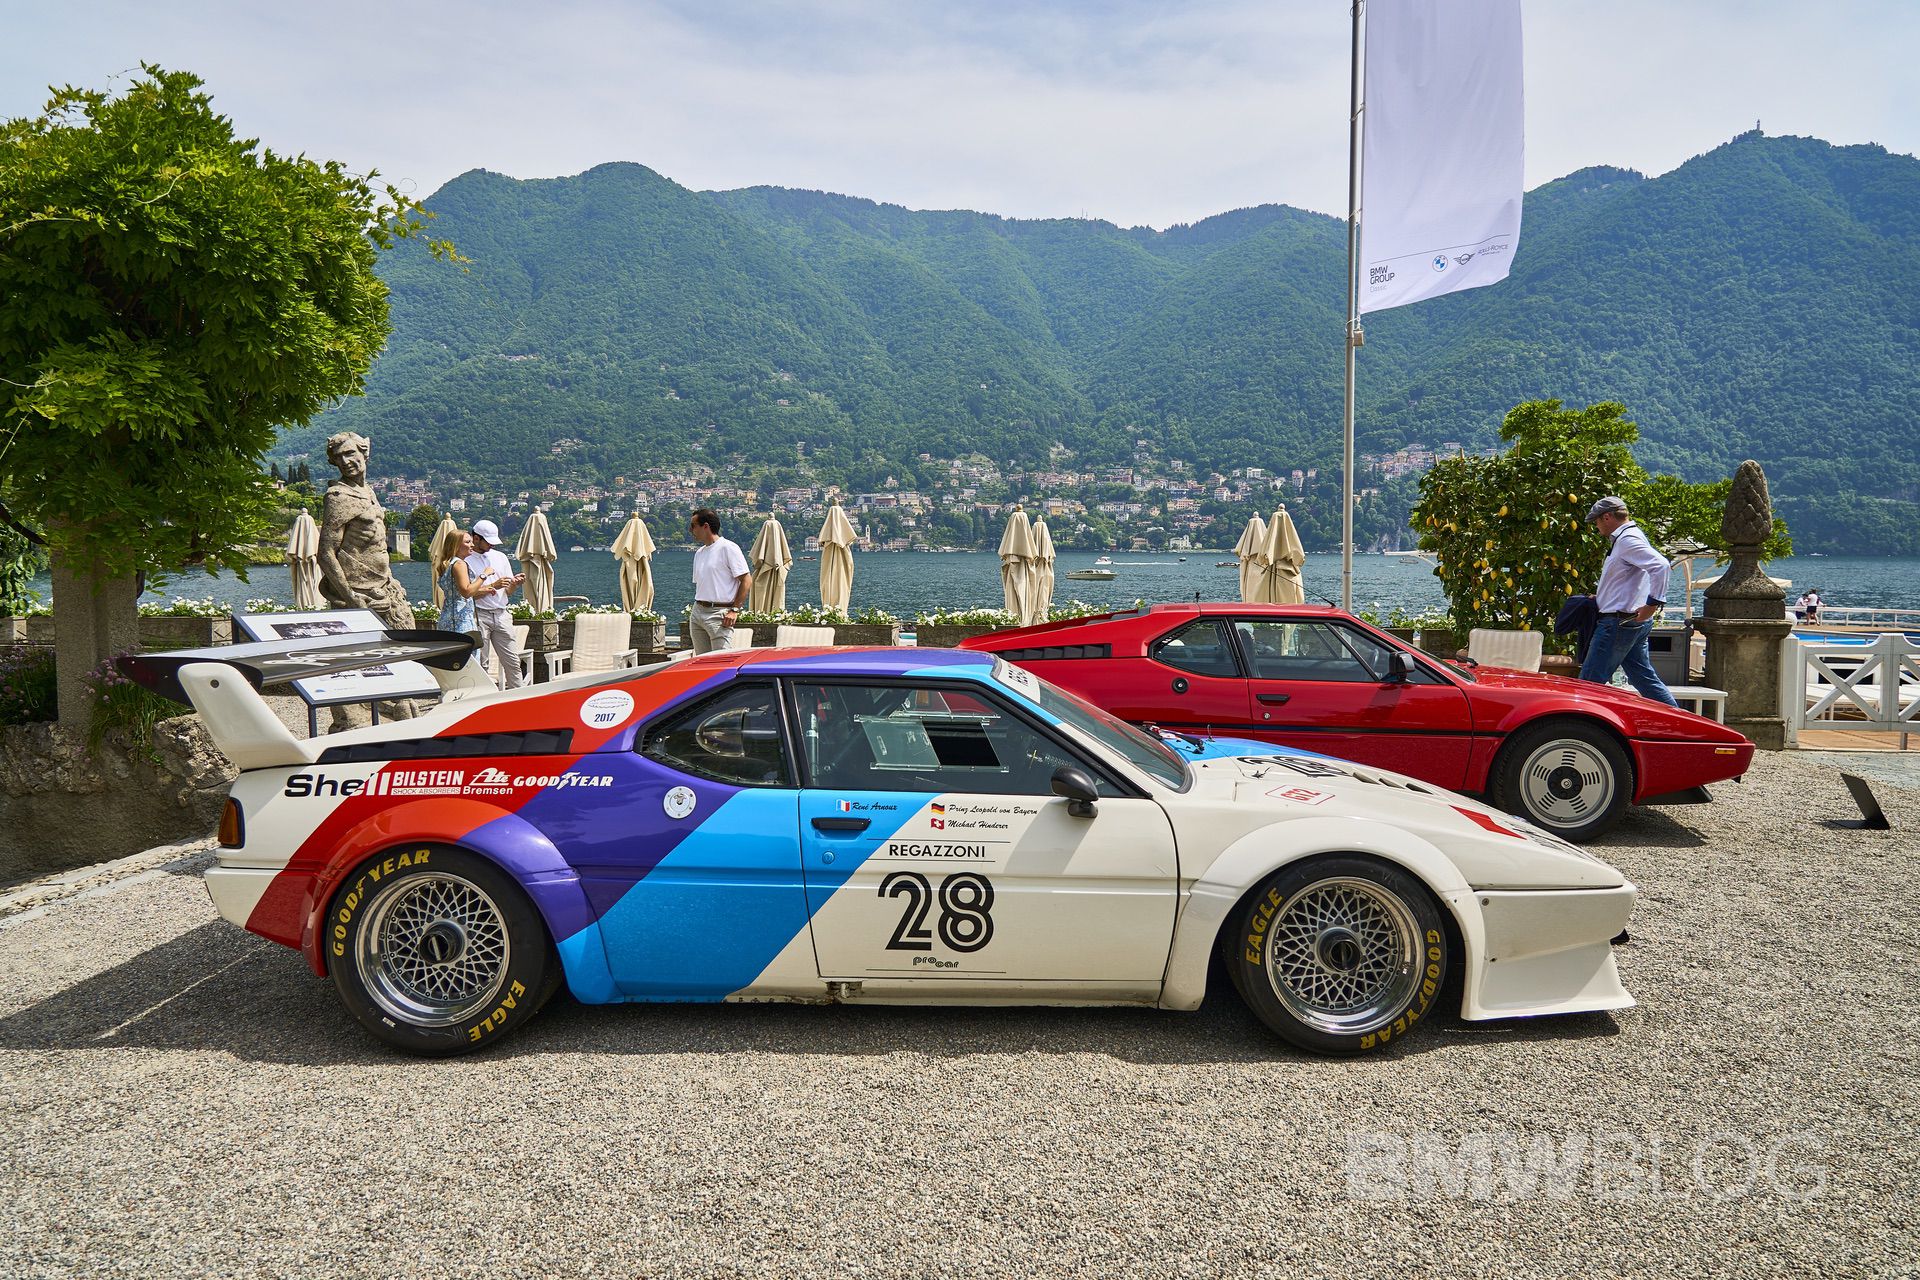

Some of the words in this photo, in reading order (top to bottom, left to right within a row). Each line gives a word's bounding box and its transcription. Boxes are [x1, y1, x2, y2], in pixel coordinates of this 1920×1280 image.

[1370, 266, 1388, 276] BMW
[1370, 273, 1394, 284] GROUP
[594, 713, 616, 722] 2017
[284, 772, 389, 797] Shell
[393, 771, 464, 787] BILSTEIN
[513, 772, 613, 790] GOODYEAR
[463, 786, 513, 795] Bremsen
[852, 802, 869, 810] René
[871, 802, 898, 811] Arnoux
[949, 805, 969, 814] Prinz
[970, 805, 998, 815] Leopold
[1013, 807, 1038, 816] Bayern
[948, 820, 976, 828] Michael
[978, 821, 1008, 829] Hinderer
[889, 845, 985, 857] REGAZZONI
[333, 849, 431, 956] GOODYEAR
[878, 871, 994, 952] 28
[1246, 887, 1284, 965] EAGLE
[1360, 929, 1441, 1050] GOODYEAR
[469, 979, 526, 1042] EAGLE
